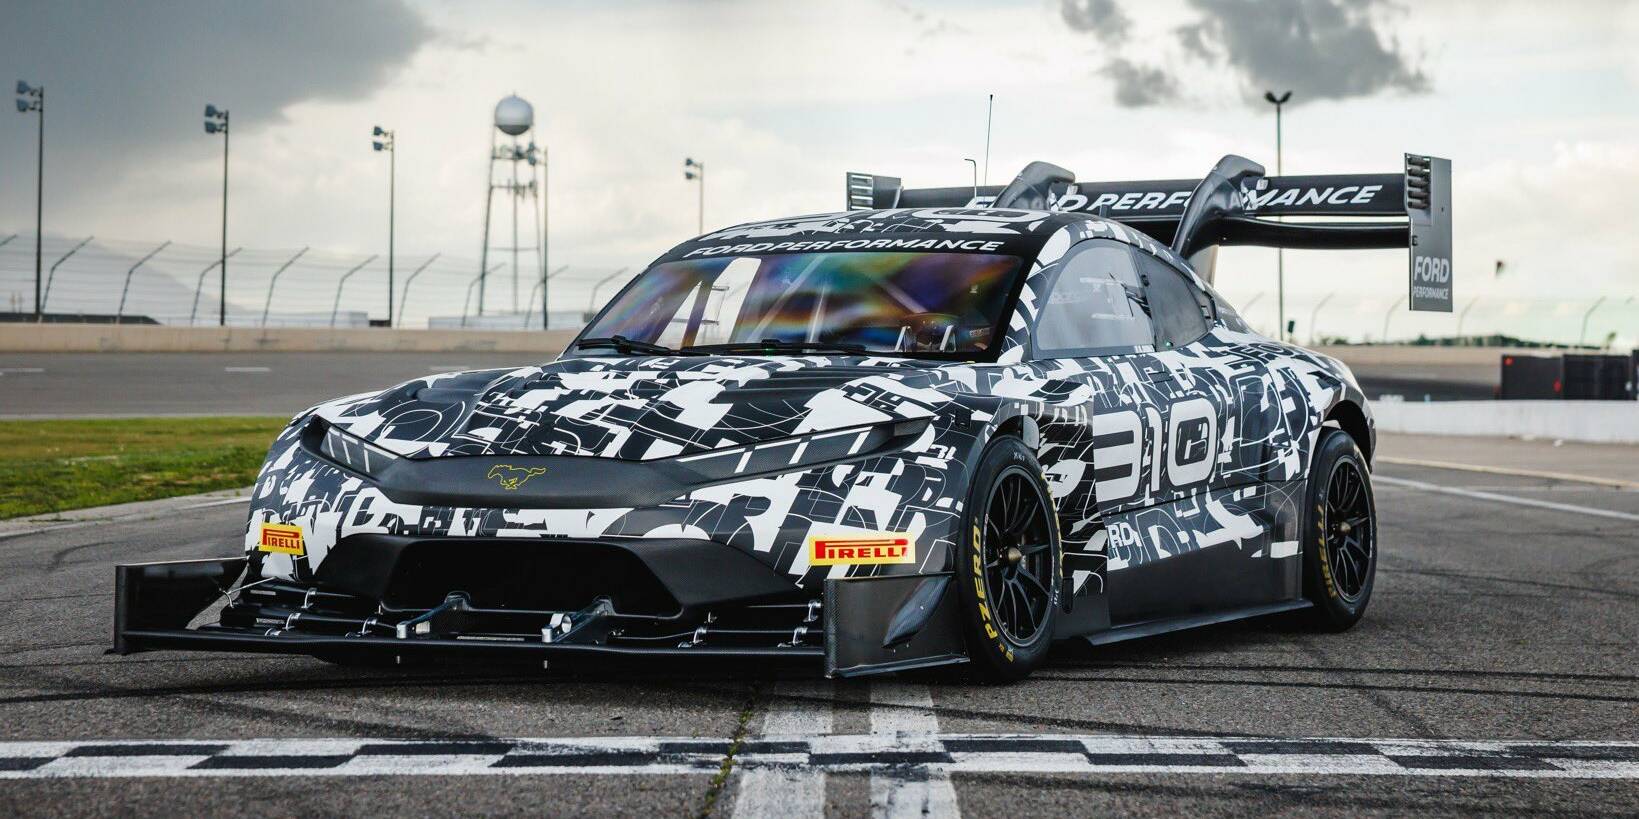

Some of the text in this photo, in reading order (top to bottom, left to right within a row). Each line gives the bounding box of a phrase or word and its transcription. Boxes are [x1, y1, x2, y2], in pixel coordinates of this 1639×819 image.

[1087, 184, 1383, 211] PERFMANCE
[1413, 255, 1450, 284] FORD
[1412, 285, 1450, 300] PERFORMANCE
[1092, 397, 1218, 503] 310
[261, 528, 300, 549] PIRELLI
[814, 538, 908, 560] PIRELLI
